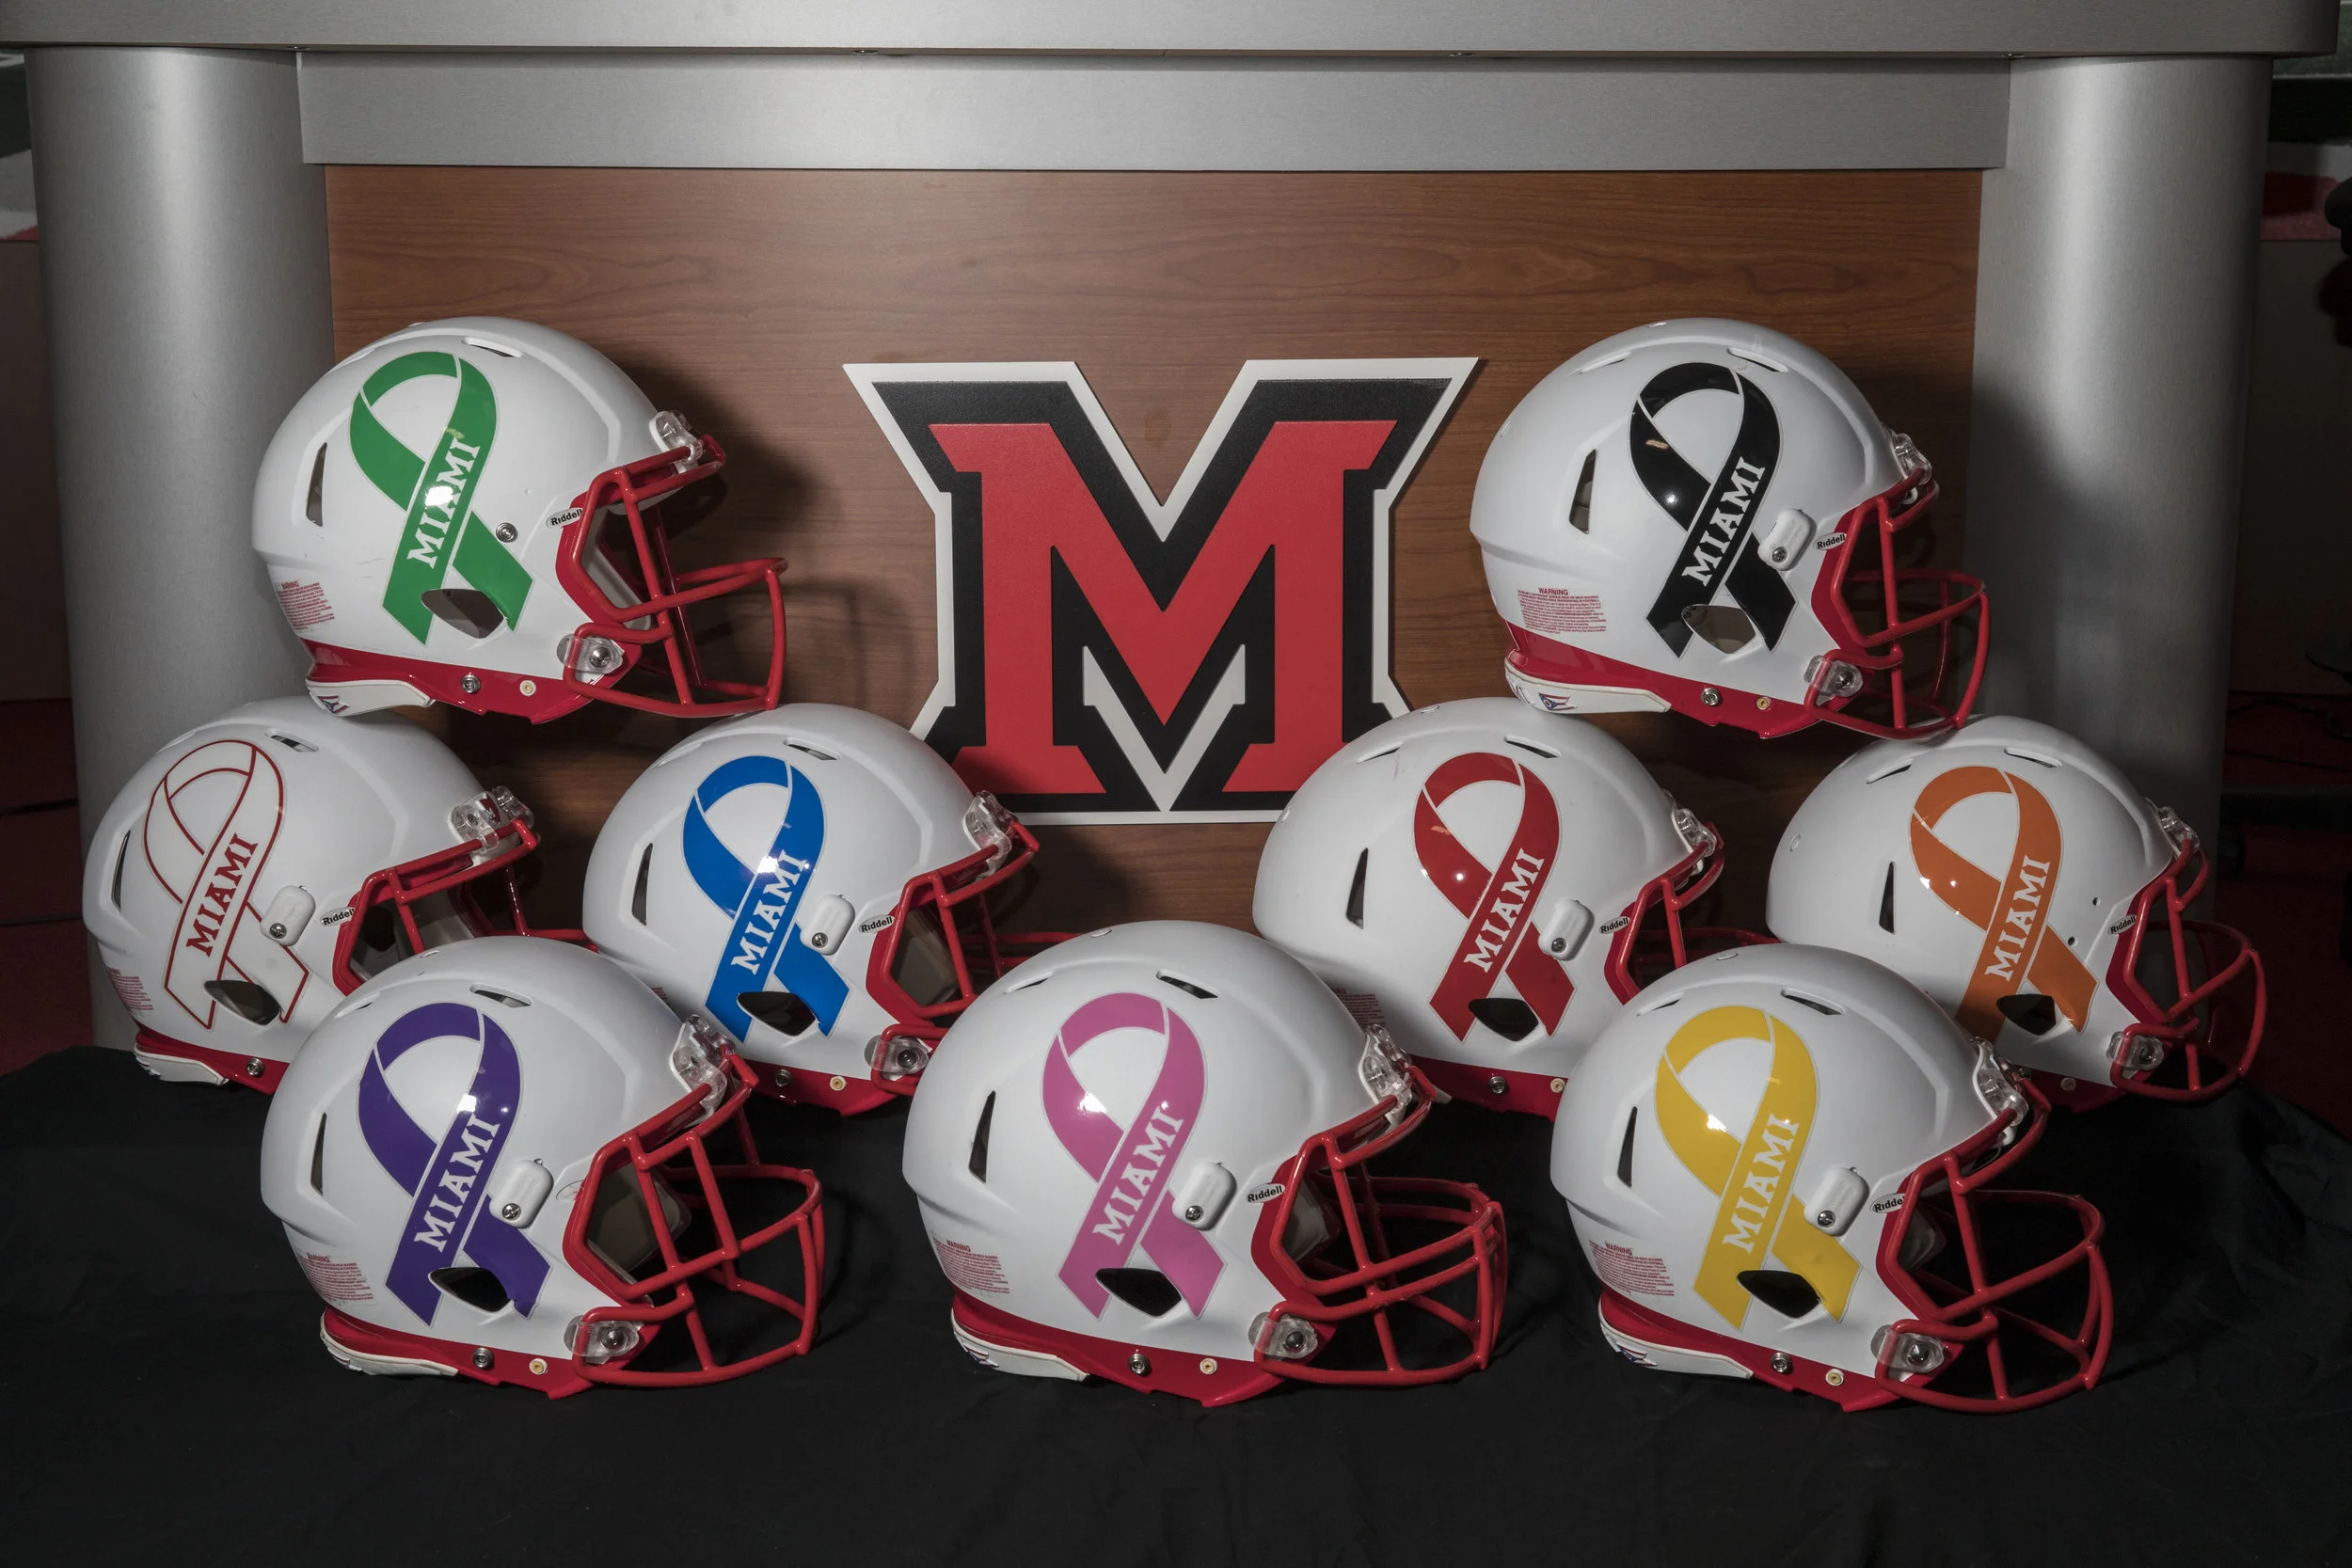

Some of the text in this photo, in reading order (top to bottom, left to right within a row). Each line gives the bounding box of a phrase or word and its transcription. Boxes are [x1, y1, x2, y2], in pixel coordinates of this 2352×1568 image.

[406, 438, 482, 568] MIAMI
[550, 509, 582, 526] Riddell
[1681, 456, 1766, 588] MIAMI
[1817, 533, 1845, 550] Riddell
[867, 372, 1454, 813] M
[1538, 587, 1568, 595] WARNING
[186, 833, 258, 958] MIAMI
[730, 849, 808, 975] MIAMI
[861, 916, 893, 932] Riddell
[1463, 847, 1545, 974] MIAMI
[1600, 917, 1629, 933] Riddell
[1984, 855, 2051, 982] MIAMI
[2110, 915, 2136, 935] Riddell
[413, 1113, 501, 1253] MIAMI
[1091, 1105, 1184, 1245] MIAMI
[1248, 1184, 1282, 1203] Riddell
[1722, 1113, 1801, 1255] MIAMI
[1874, 1196, 1906, 1213] Ridde
